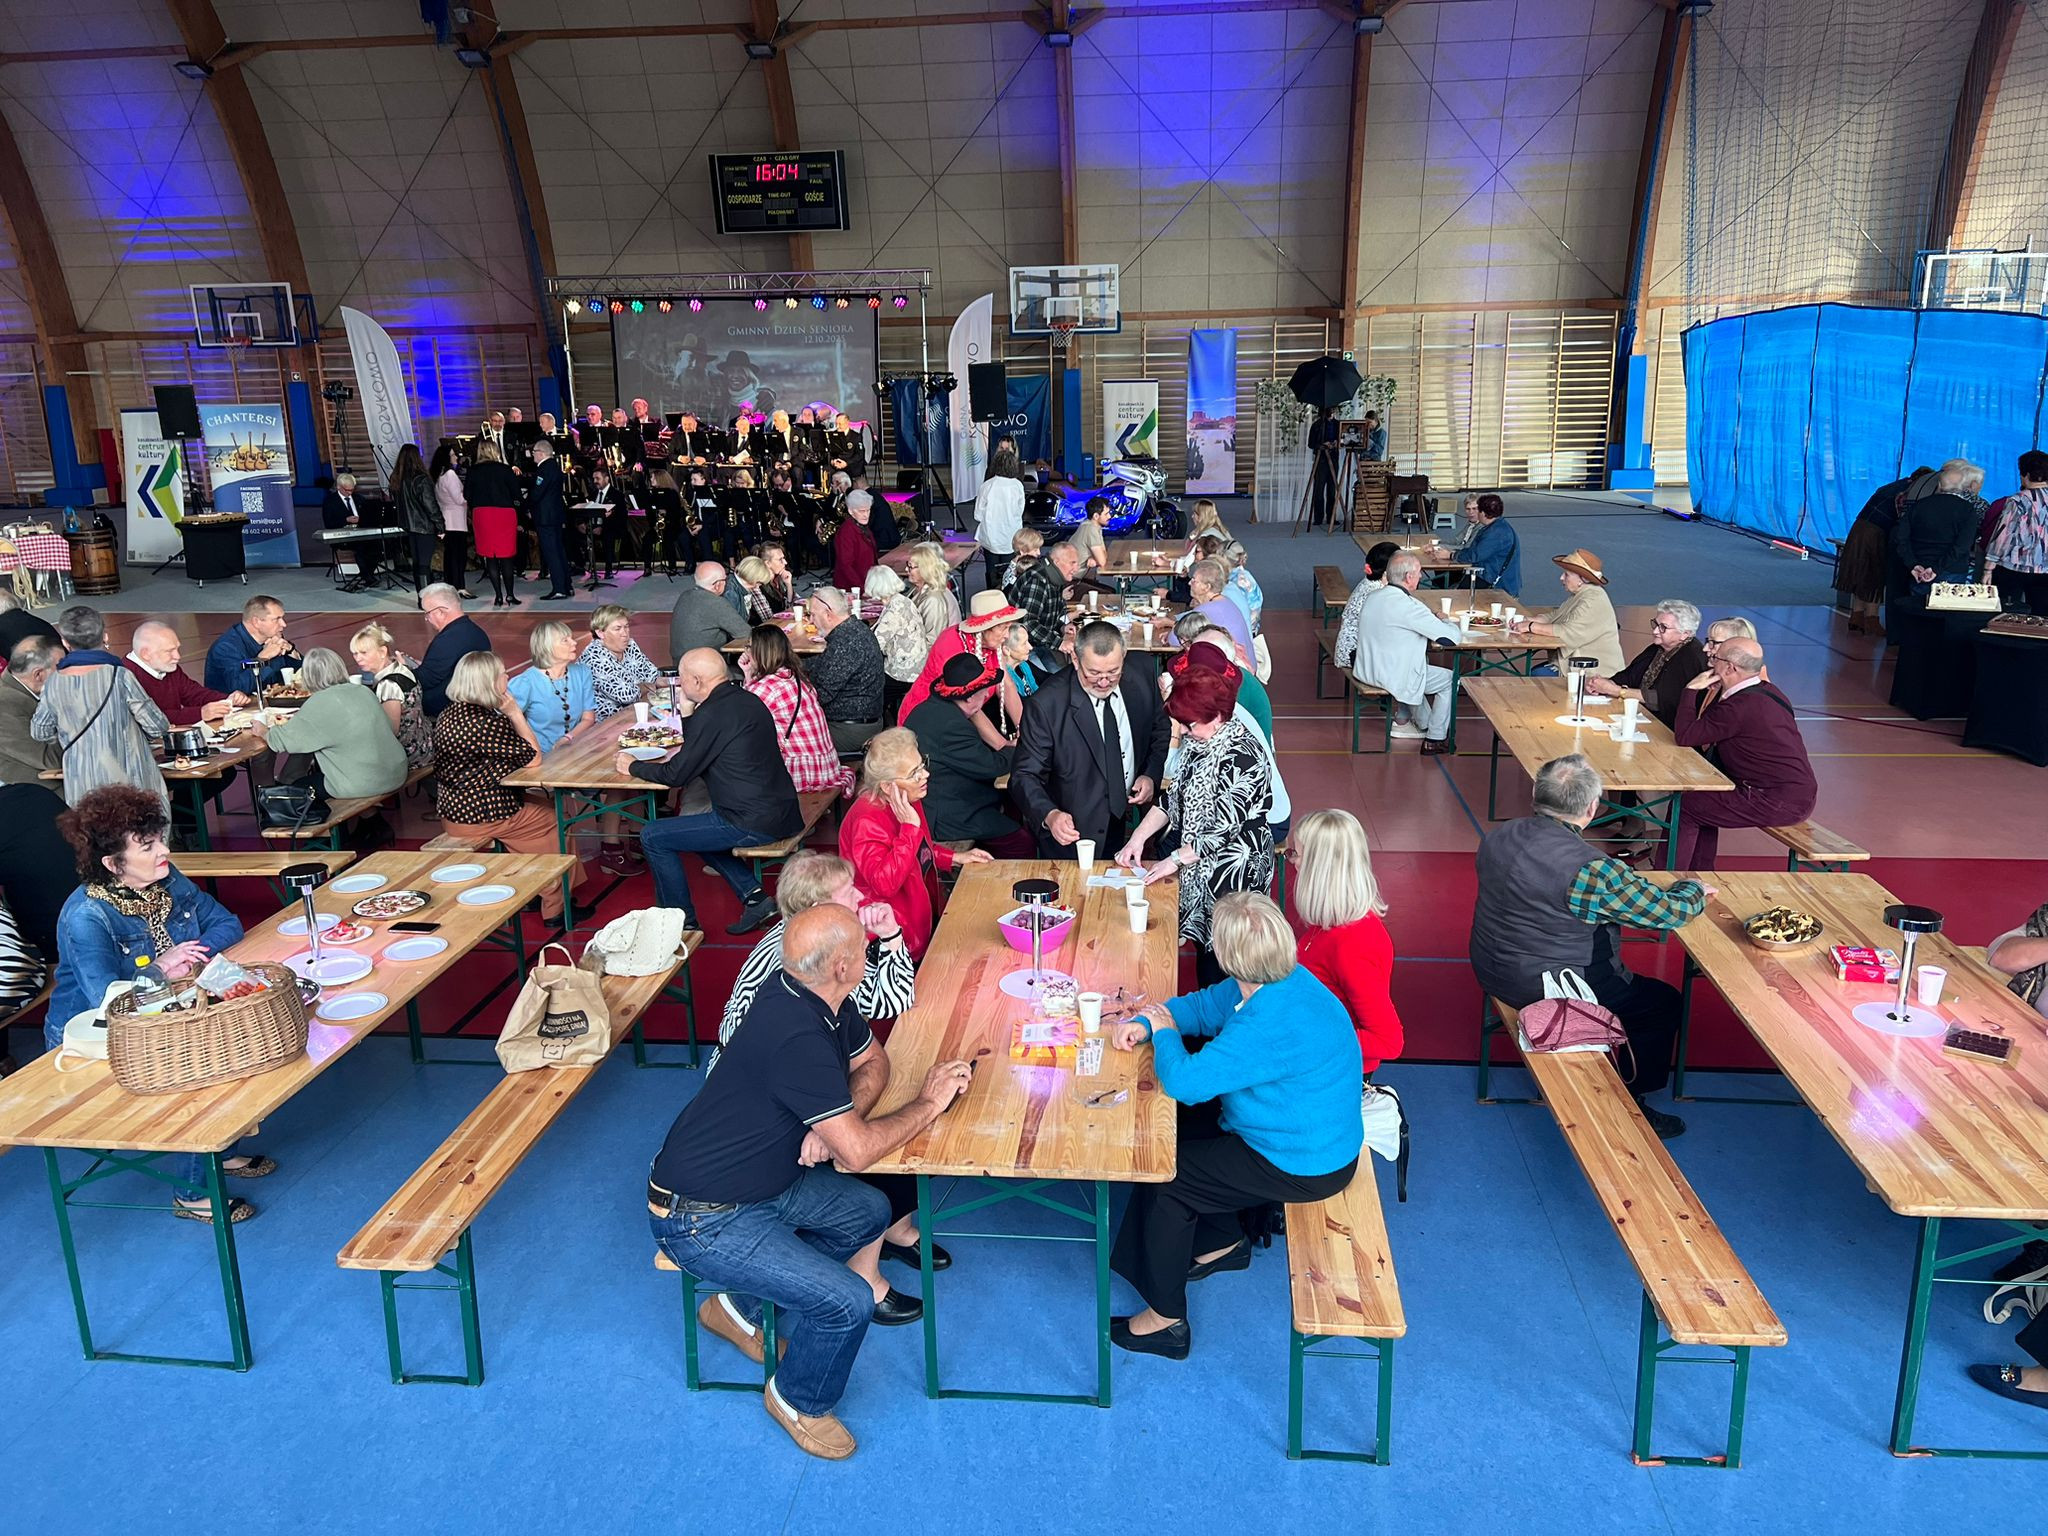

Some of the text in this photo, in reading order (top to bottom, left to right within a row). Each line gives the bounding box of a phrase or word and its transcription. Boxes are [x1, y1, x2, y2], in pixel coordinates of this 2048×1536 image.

[756, 164, 799, 181] 16:04
[727, 194, 763, 204] GOSPODARZE
[804, 190, 825, 202] GOŚCIE
[727, 326, 770, 336] GMINNY
[810, 324, 854, 335] SENIORA
[206, 412, 276, 427] CHANTERSI
[1009, 428, 1028, 437] sport
[138, 451, 165, 459] kultury
